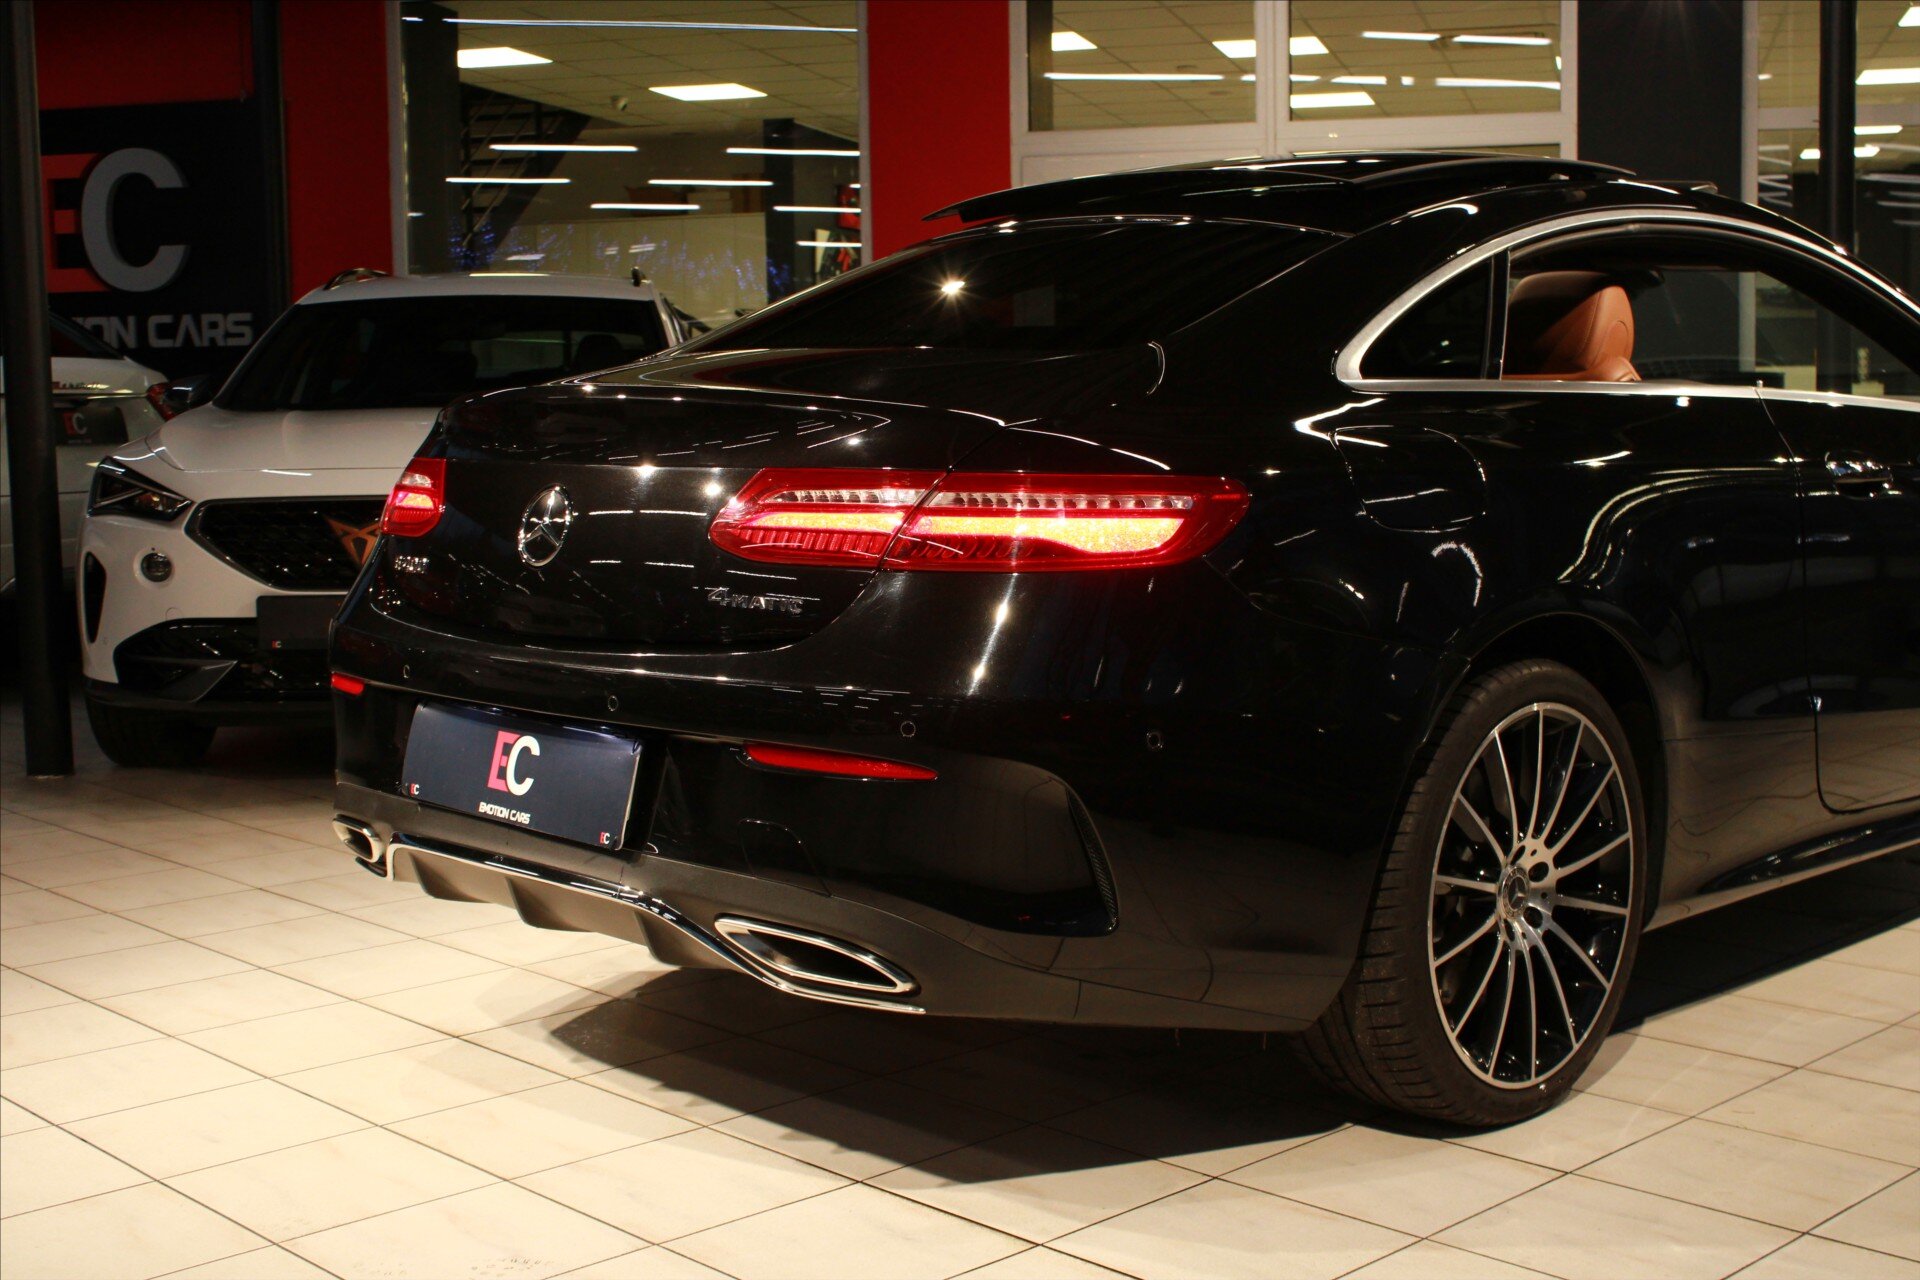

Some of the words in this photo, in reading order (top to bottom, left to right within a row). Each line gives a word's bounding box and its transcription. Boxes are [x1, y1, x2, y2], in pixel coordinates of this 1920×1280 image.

[41, 148, 189, 292] EC
[147, 313, 252, 347] CARS
[487, 730, 540, 796] EC
[478, 801, 510, 820] EMOTION
[509, 809, 530, 825] CARS
